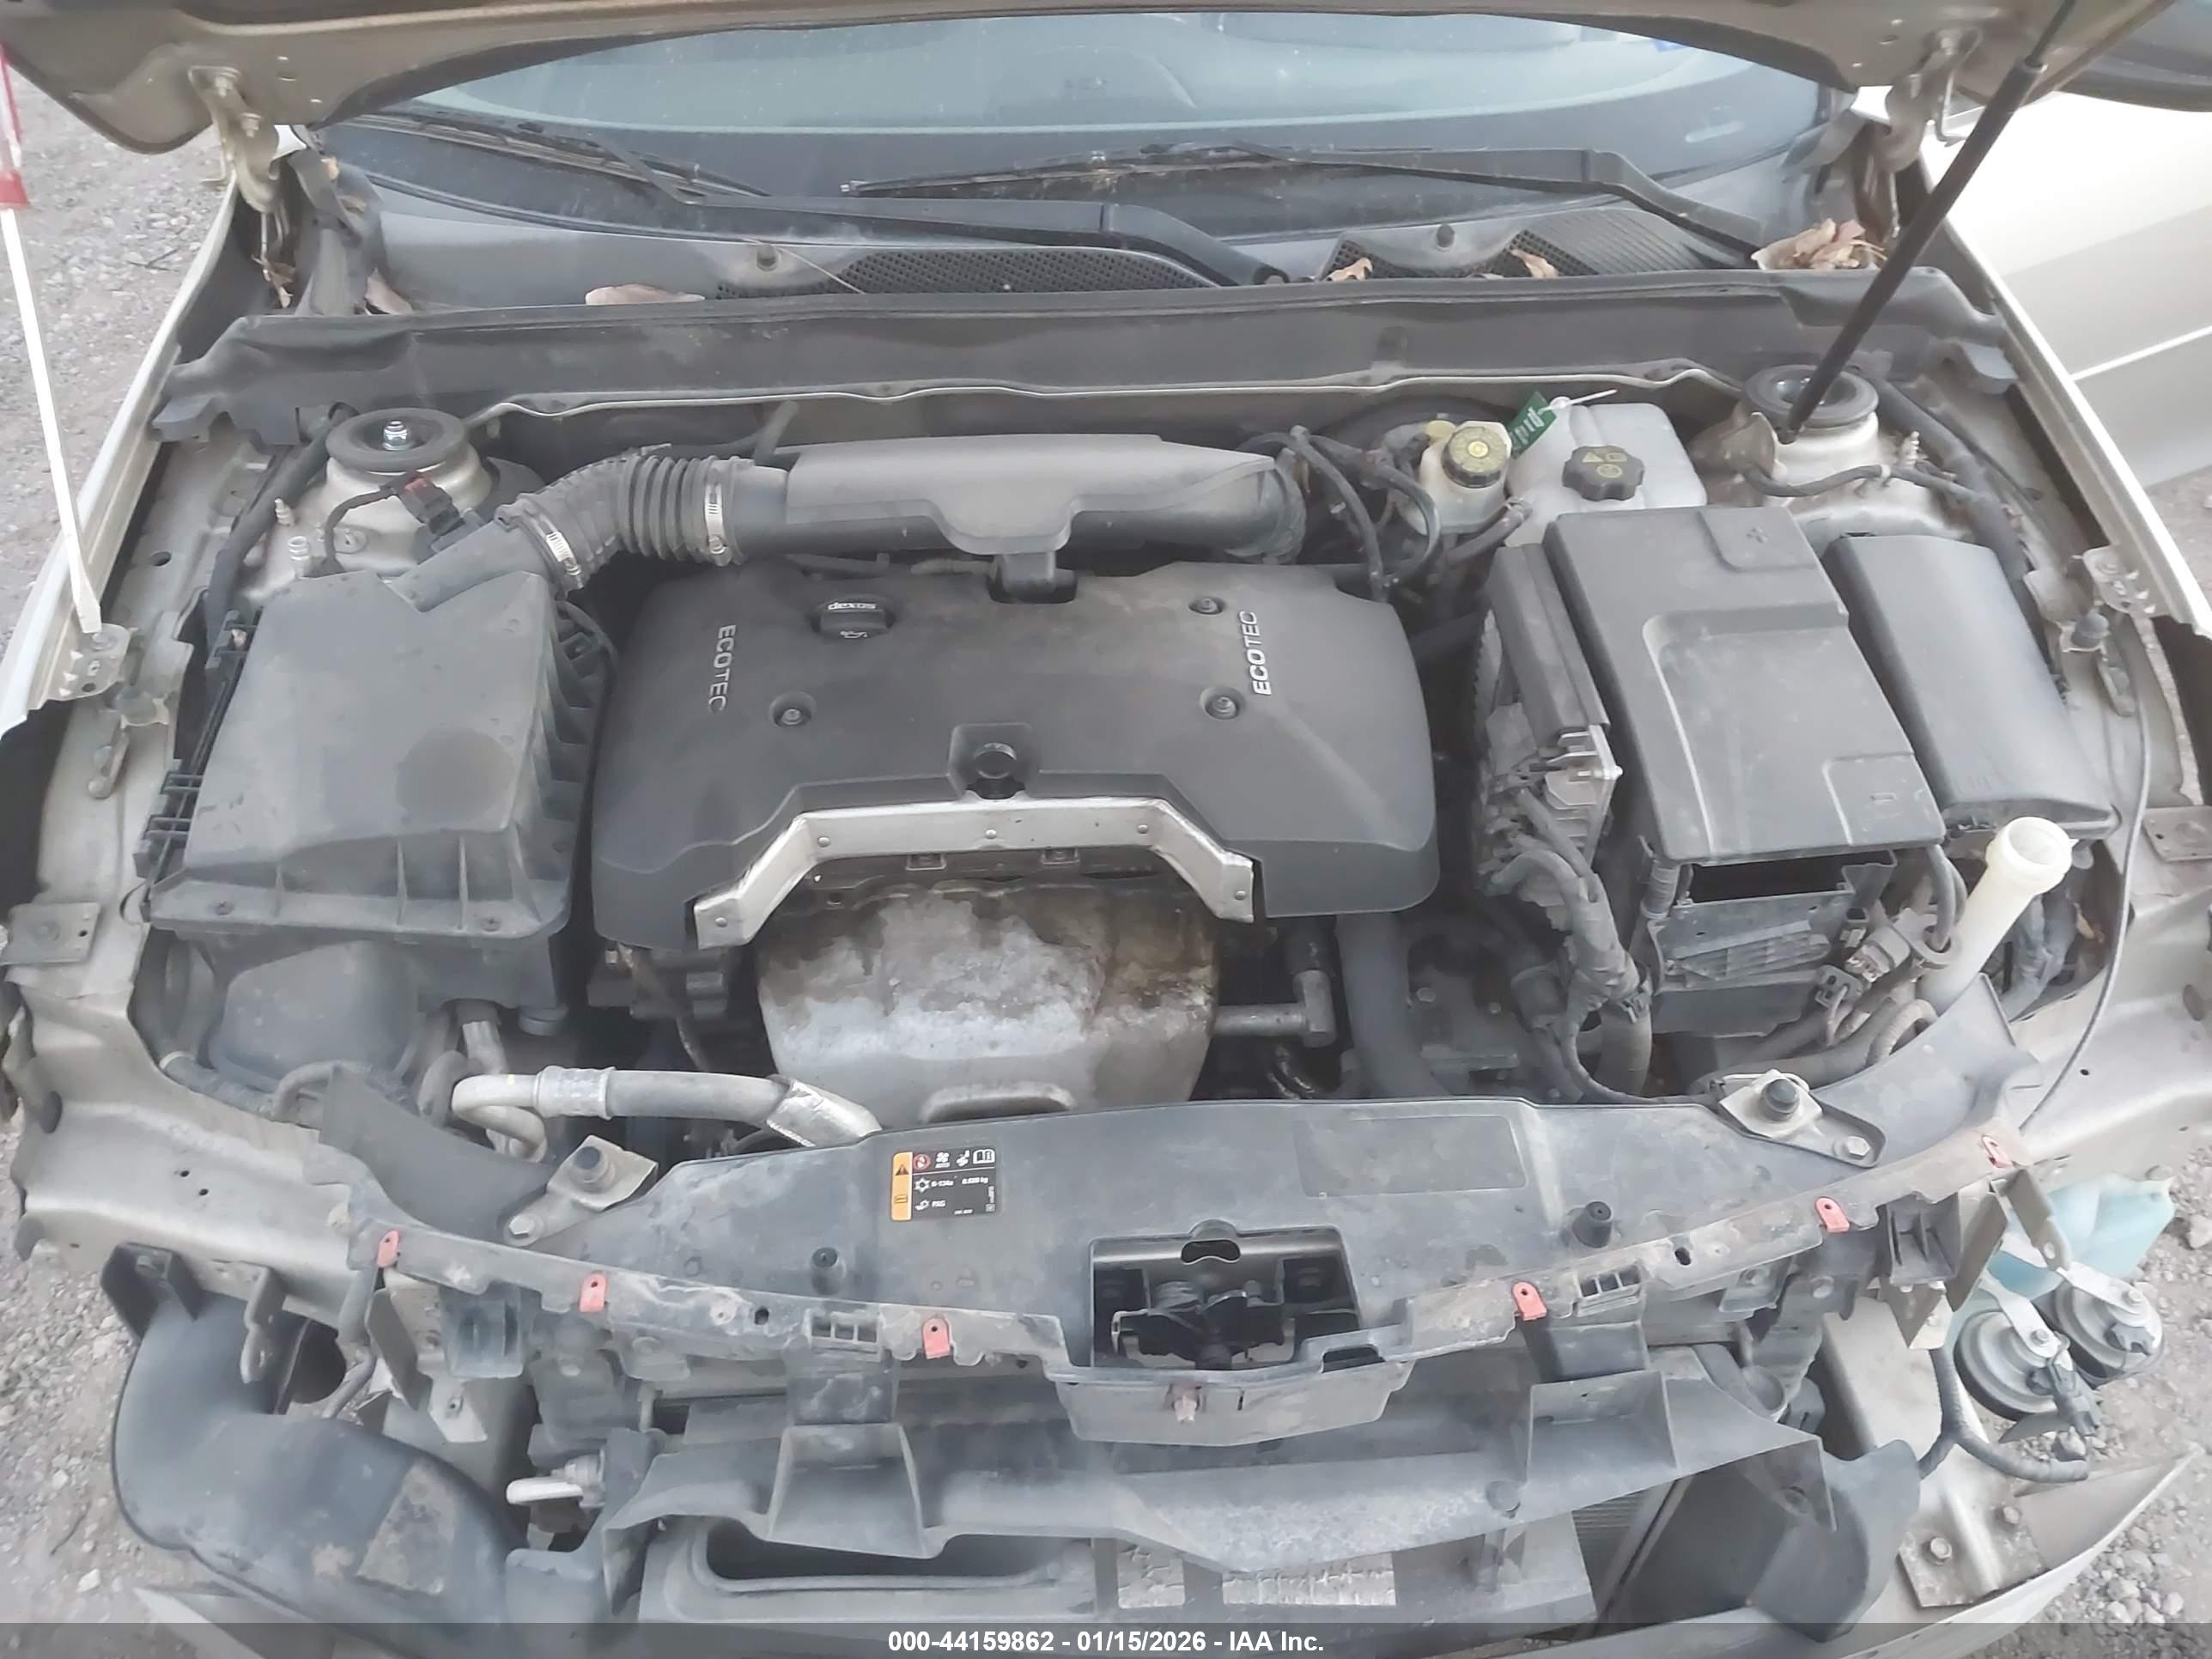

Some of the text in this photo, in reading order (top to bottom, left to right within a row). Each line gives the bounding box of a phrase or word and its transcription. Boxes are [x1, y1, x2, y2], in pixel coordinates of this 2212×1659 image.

[828, 602, 876, 611] dexos
[708, 624, 737, 714] ECOTEC
[1239, 611, 1272, 696] ECOTEC
